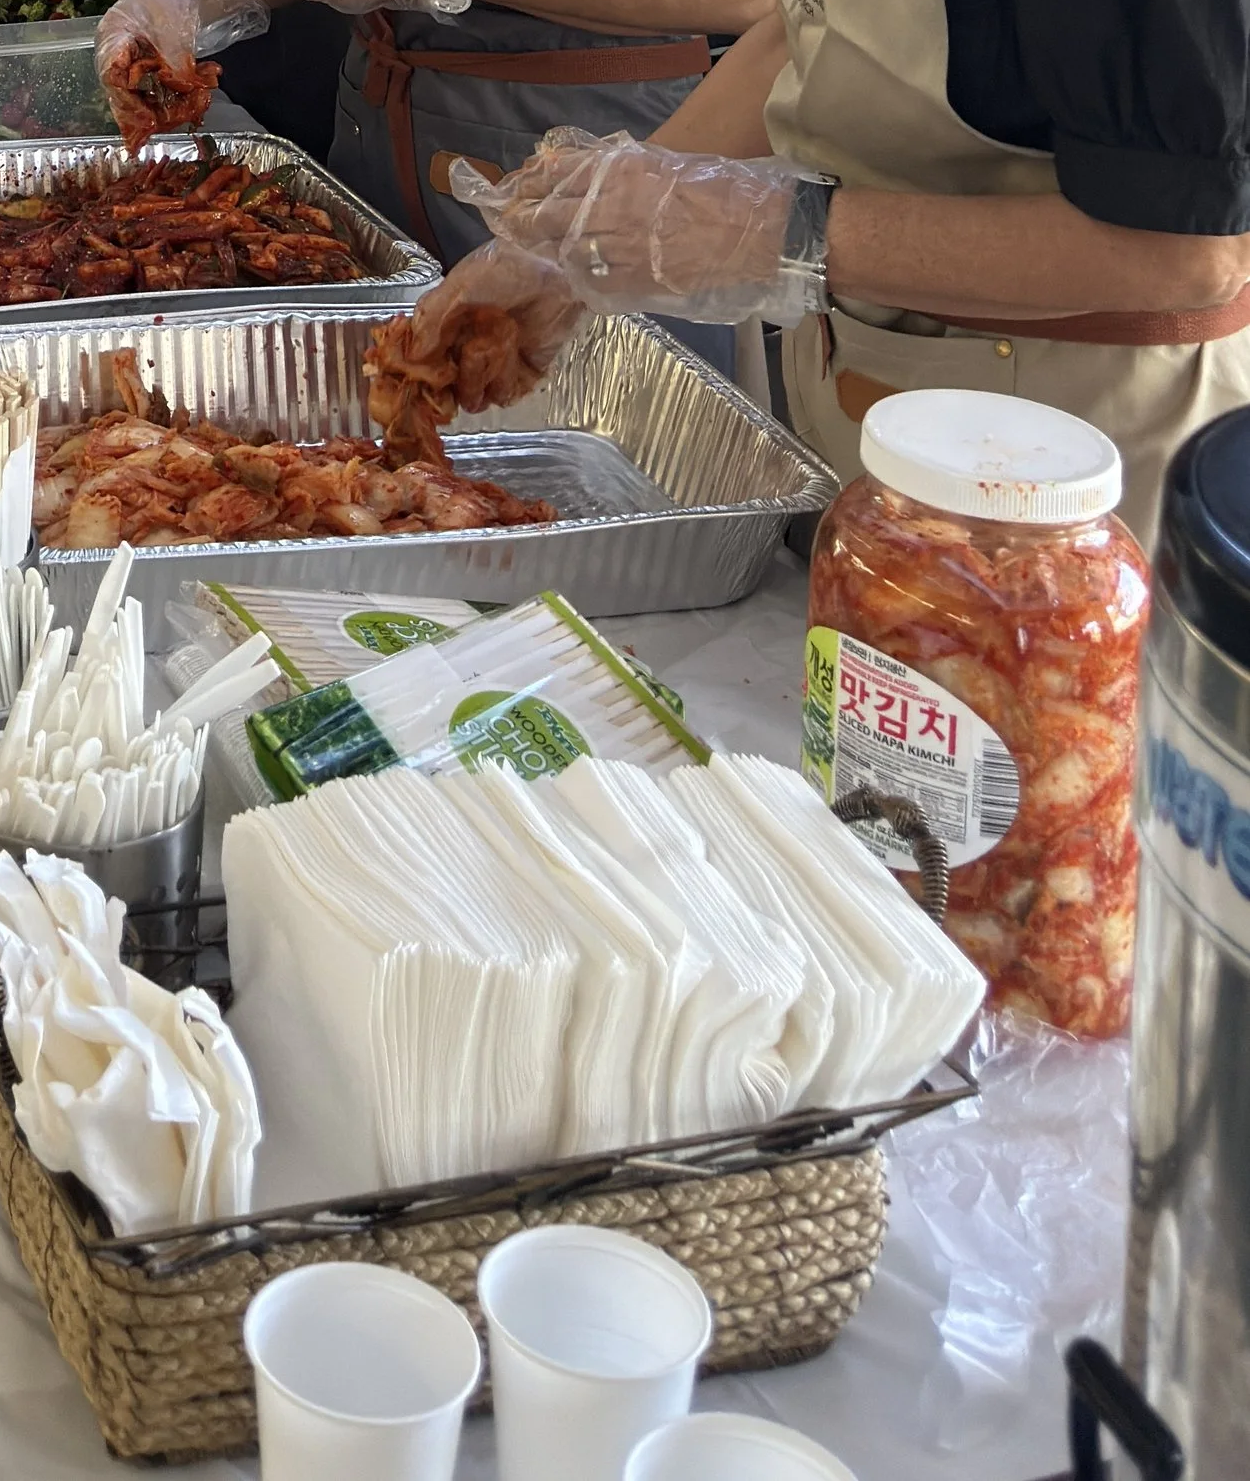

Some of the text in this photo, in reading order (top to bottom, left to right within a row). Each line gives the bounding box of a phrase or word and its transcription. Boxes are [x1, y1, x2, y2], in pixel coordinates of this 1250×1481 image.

[839, 668, 958, 756] 맛김치
[839, 710, 956, 768] SLICED NAPA KIMCHI
